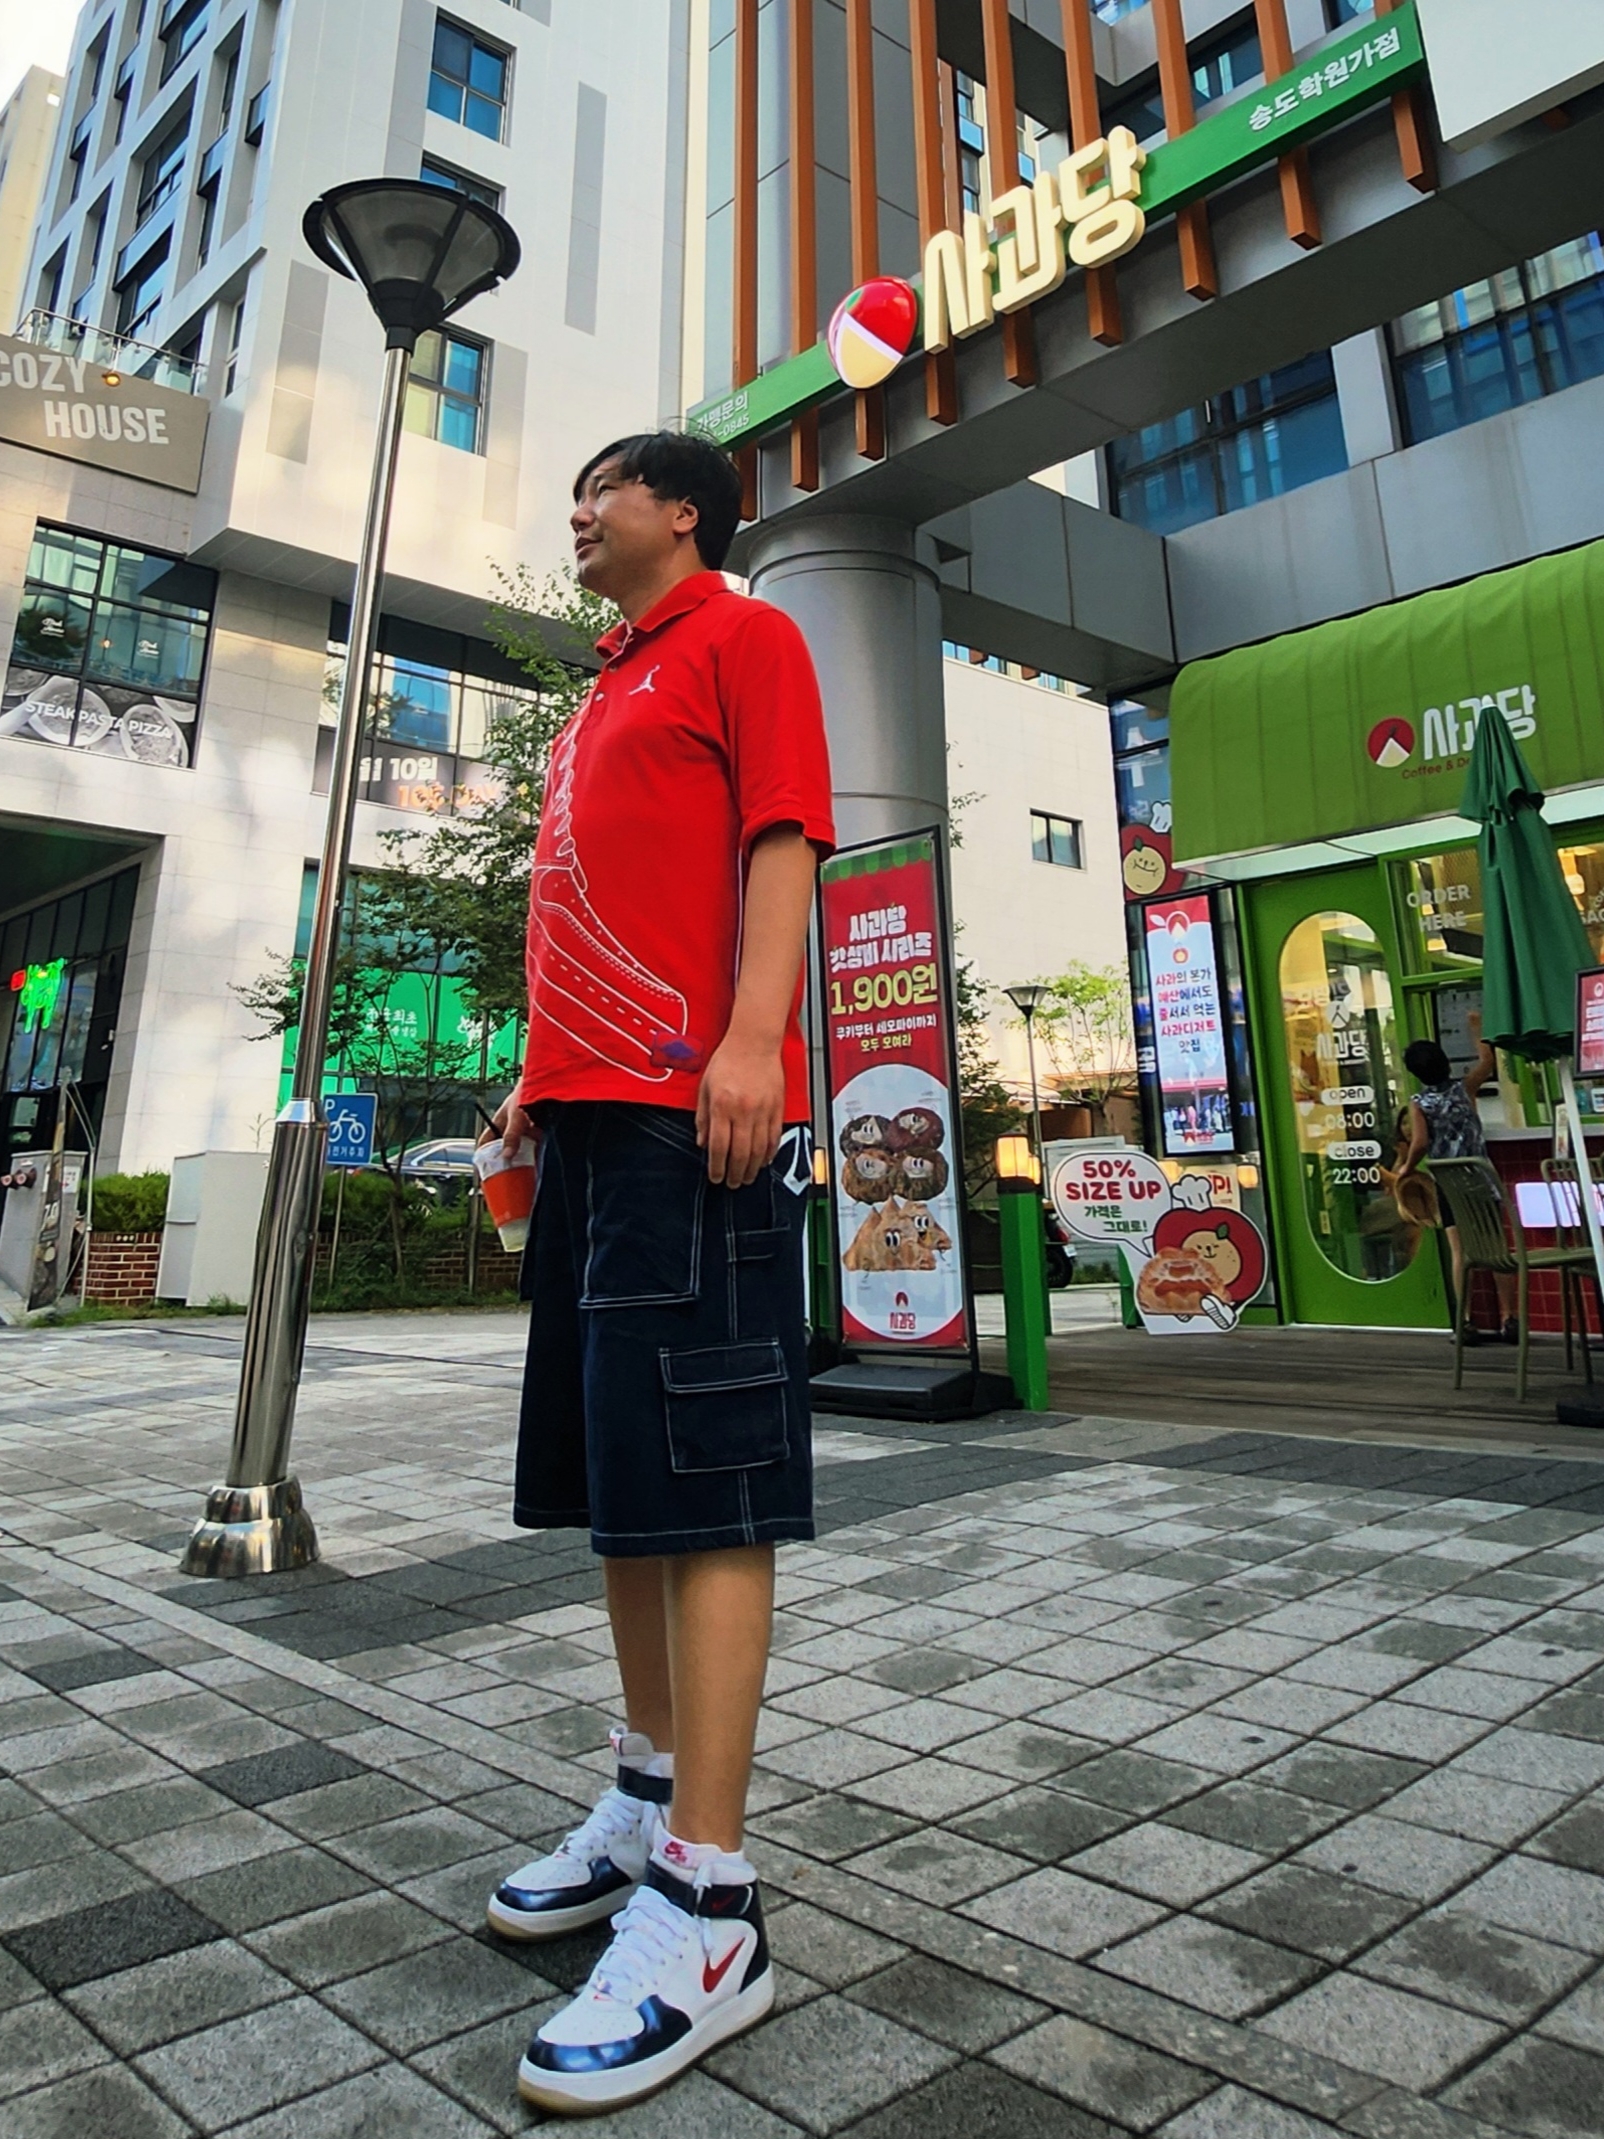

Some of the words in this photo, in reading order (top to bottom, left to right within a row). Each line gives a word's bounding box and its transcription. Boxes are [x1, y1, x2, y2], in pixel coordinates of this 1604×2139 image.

[1249, 27, 1401, 131] 송도학원가점
[924, 125, 1147, 355] 사과당
[44, 400, 169, 445] HOUSE
[25, 700, 76, 722] STEAK
[78, 708, 124, 730] PASTA
[129, 720, 174, 740] PIZZA
[390, 756, 438, 781] 10일
[1402, 763, 1443, 780] Coffee
[1445, 759, 1455, 771] &
[1406, 884, 1471, 908] ORDER
[849, 904, 907, 942] 사과당
[1419, 910, 1468, 932] HERE
[881, 931, 932, 963] 시리즈
[830, 962, 938, 1015] 1,900원
[1155, 970, 1187, 987] 사과의
[836, 1022, 874, 1041] 쿠키부터
[1328, 1086, 1367, 1101] open
[325, 1099, 336, 1112] P
[1324, 1111, 1376, 1130] 08:00
[1334, 1145, 1375, 1158] close
[1083, 1159, 1137, 1179] 50%
[1332, 1166, 1380, 1184] 22:00
[1066, 1181, 1123, 1201] SIZE
[1128, 1180, 1162, 1200] UP
[1084, 1204, 1122, 1219] 가격은
[1102, 1219, 1148, 1234] 그대로!
